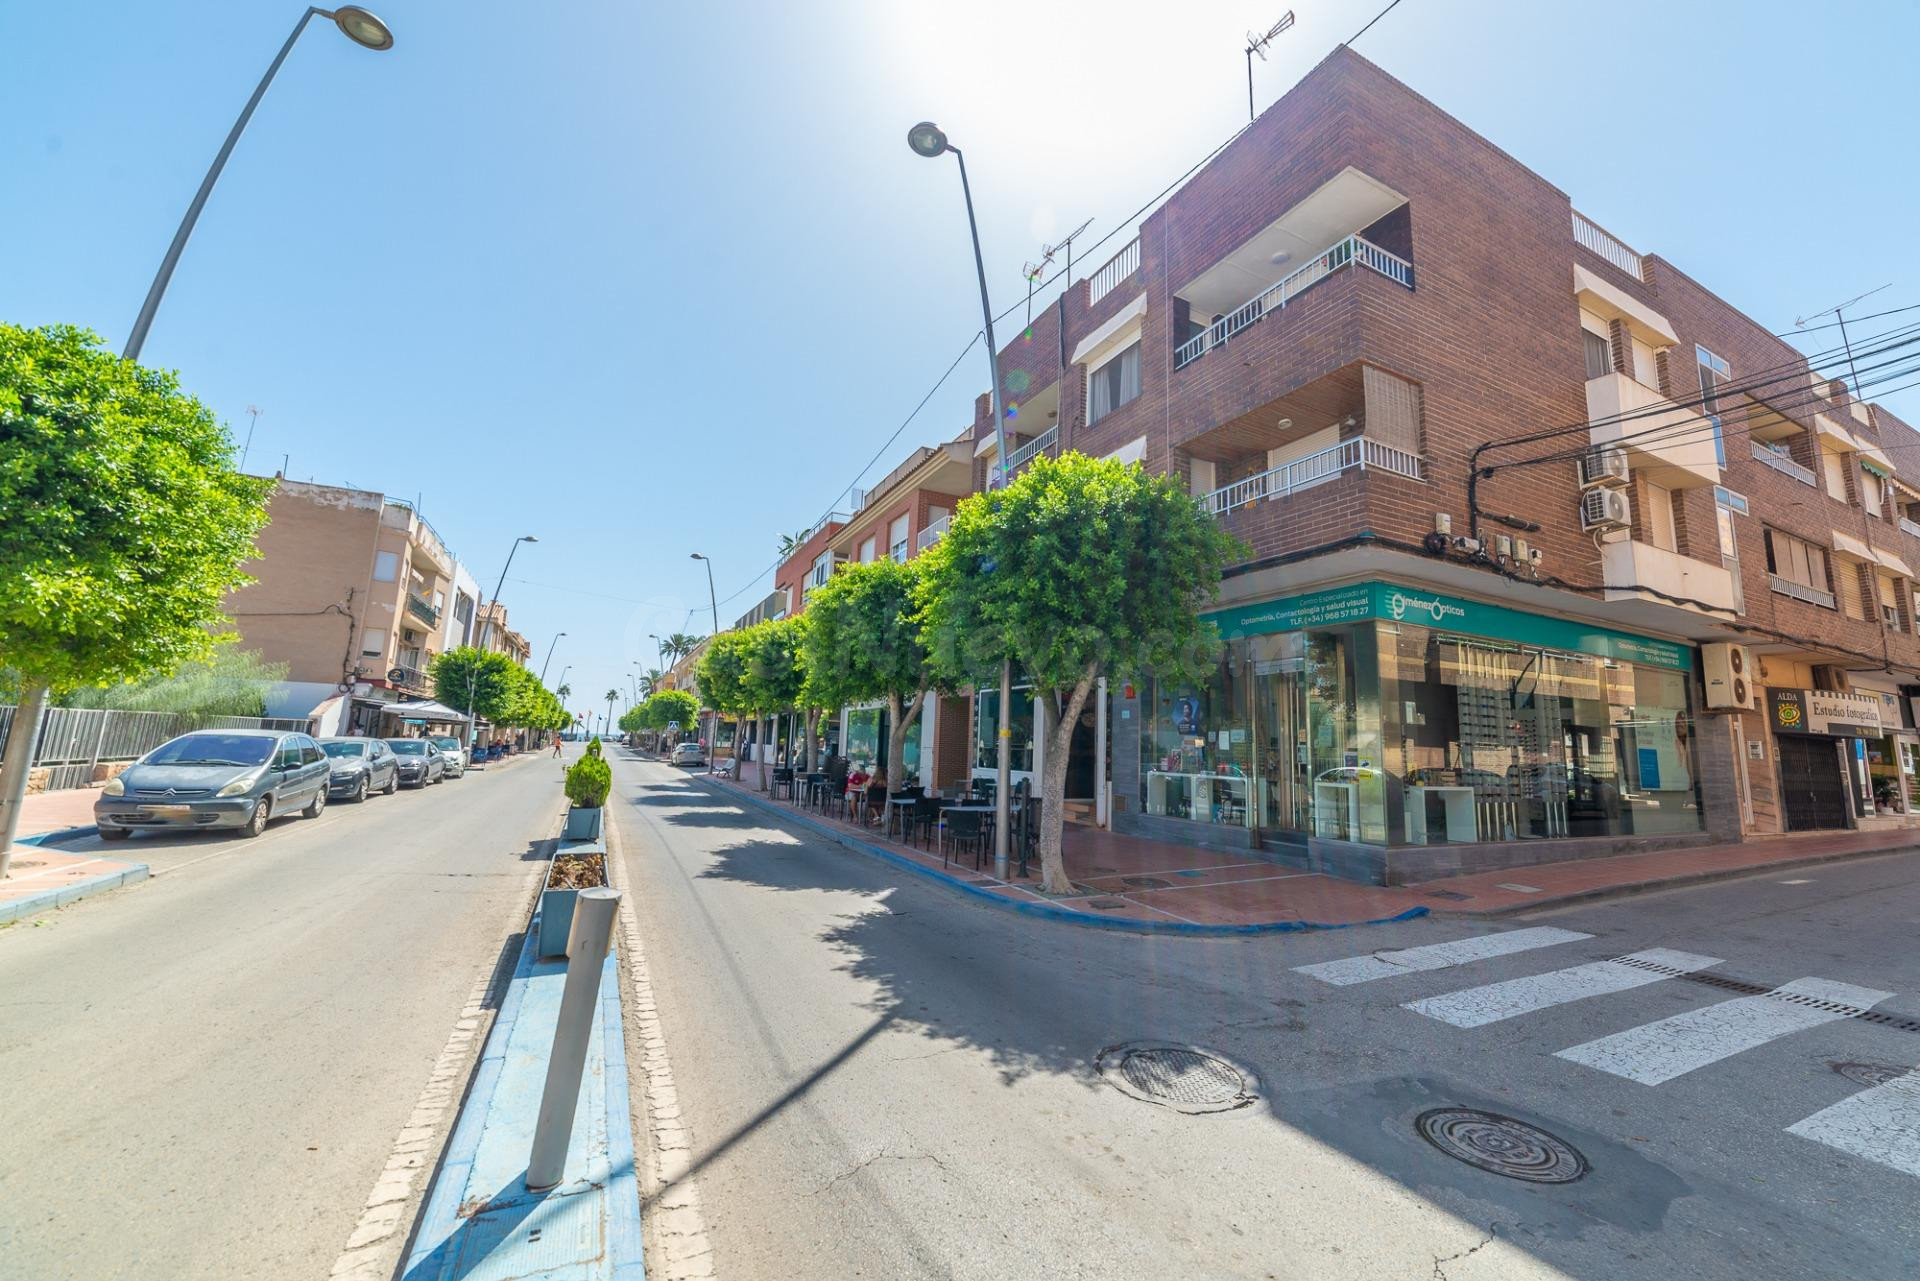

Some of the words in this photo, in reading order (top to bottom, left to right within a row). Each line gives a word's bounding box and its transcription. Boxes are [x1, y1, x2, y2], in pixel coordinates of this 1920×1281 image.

[1326, 600, 1345, 611] salud
[1346, 597, 1368, 607] visual
[1324, 611, 1339, 621] 968
[1340, 609, 1349, 618] 57
[1359, 606, 1369, 615] 27
[1777, 692, 1798, 702] ALDA
[1813, 701, 1846, 719] Estudio
